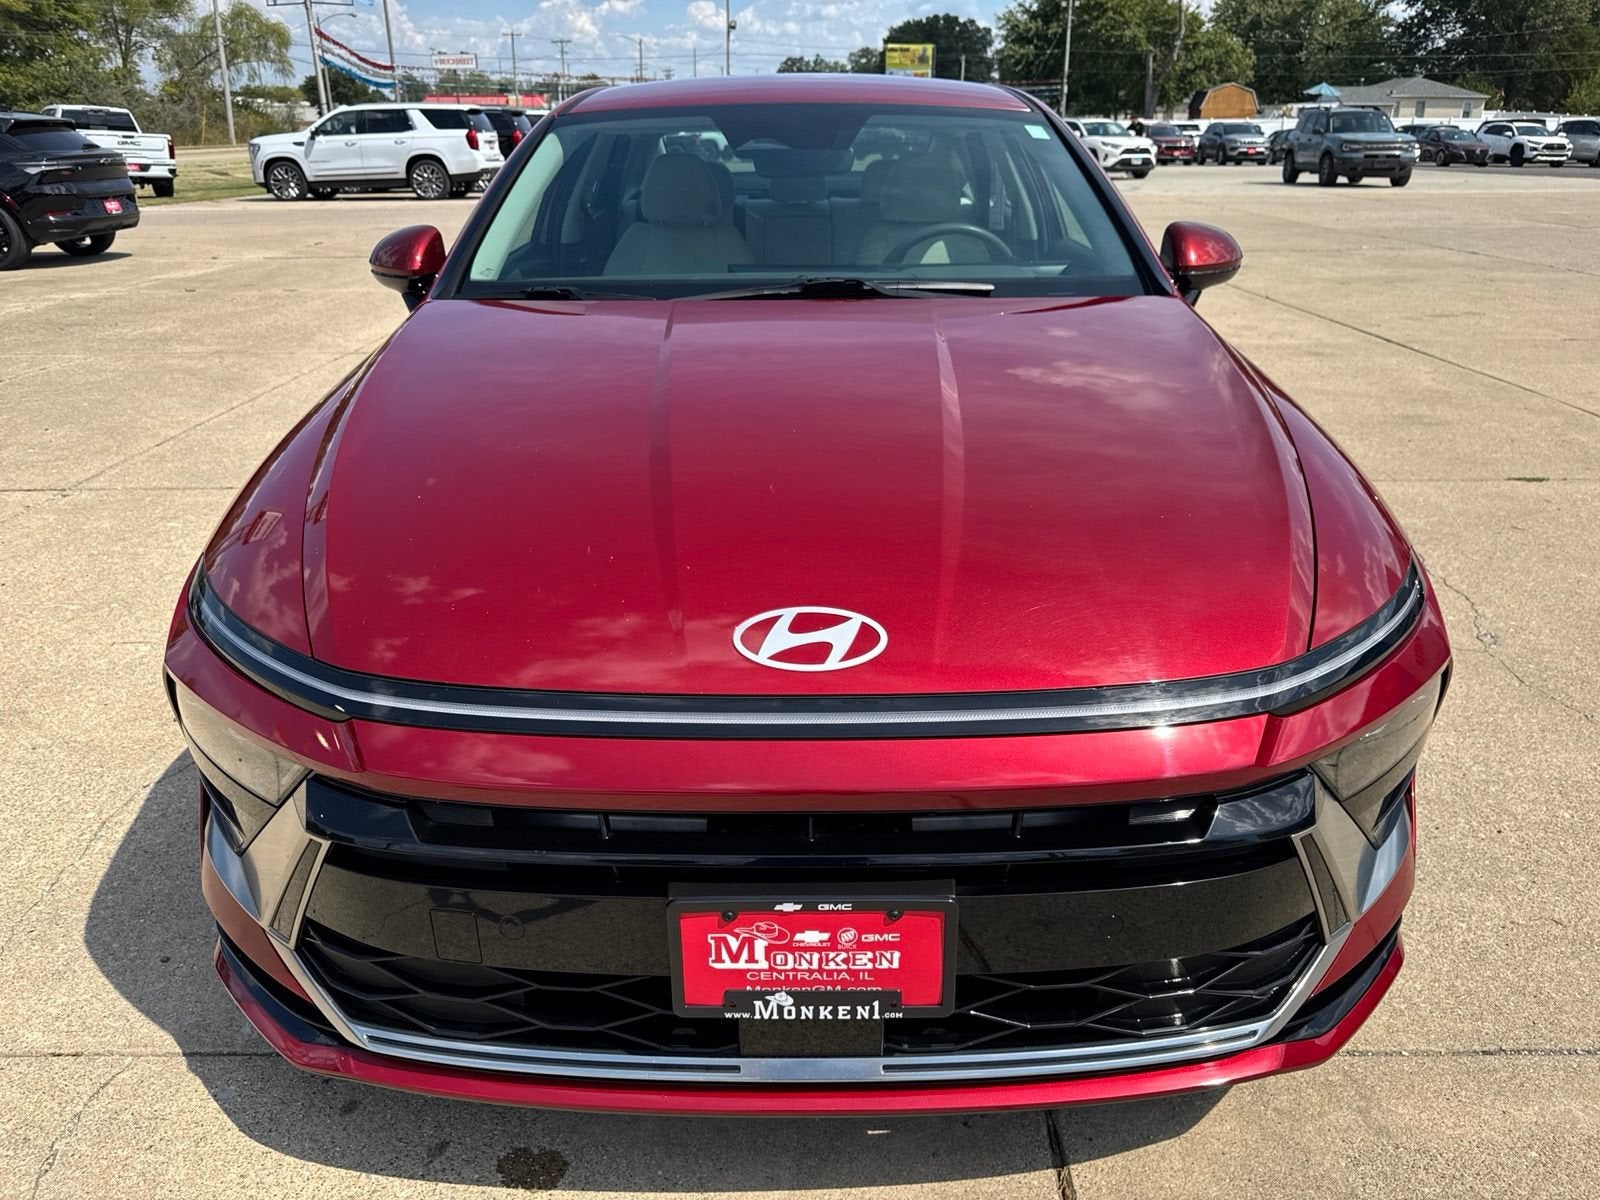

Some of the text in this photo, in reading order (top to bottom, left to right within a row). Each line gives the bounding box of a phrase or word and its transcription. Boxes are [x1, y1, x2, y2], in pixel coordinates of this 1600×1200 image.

[818, 903, 853, 911] GMC
[861, 933, 901, 943] GMC
[746, 971, 875, 982] CENTRALIA, IL
